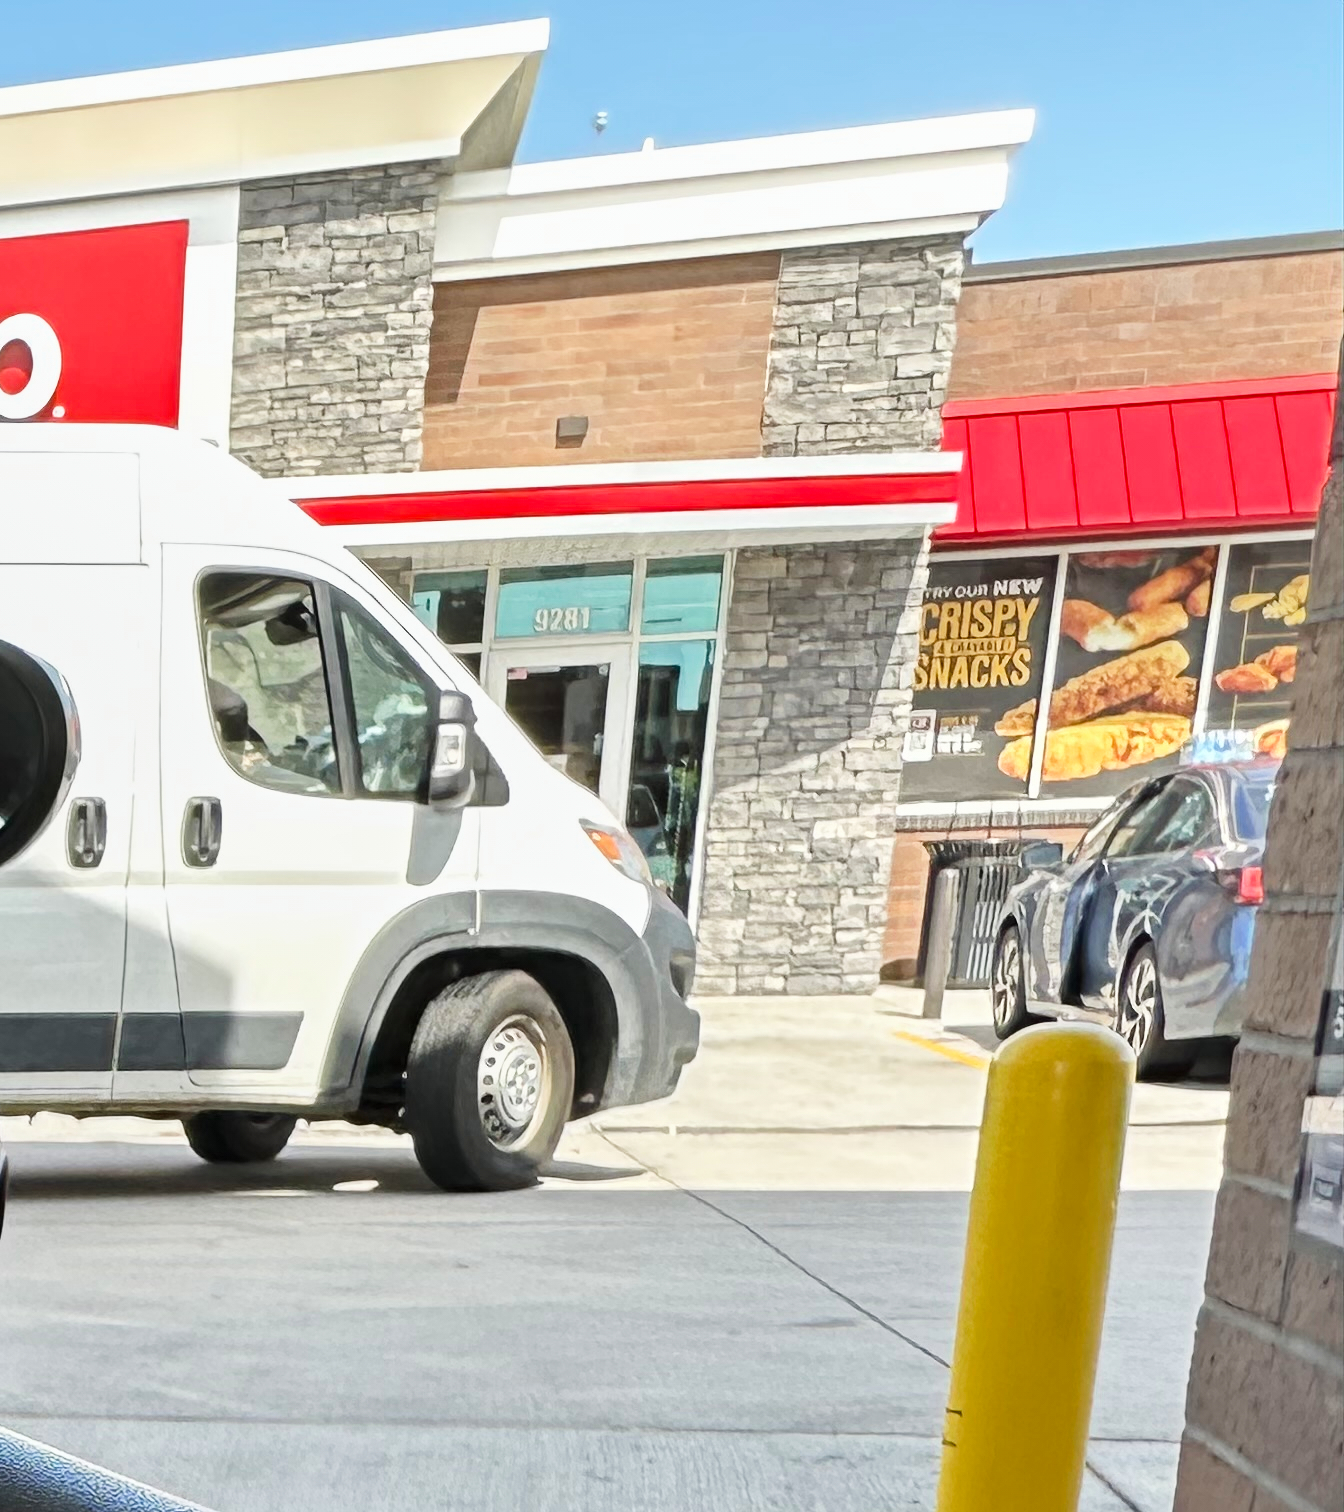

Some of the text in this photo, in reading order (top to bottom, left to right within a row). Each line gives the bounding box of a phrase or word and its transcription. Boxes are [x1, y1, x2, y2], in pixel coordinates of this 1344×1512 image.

[924, 576, 1044, 600] TRY OUR NEW
[533, 606, 590, 632] 9281
[920, 597, 1040, 646] CRISPY
[912, 648, 1032, 691] SNACKS
